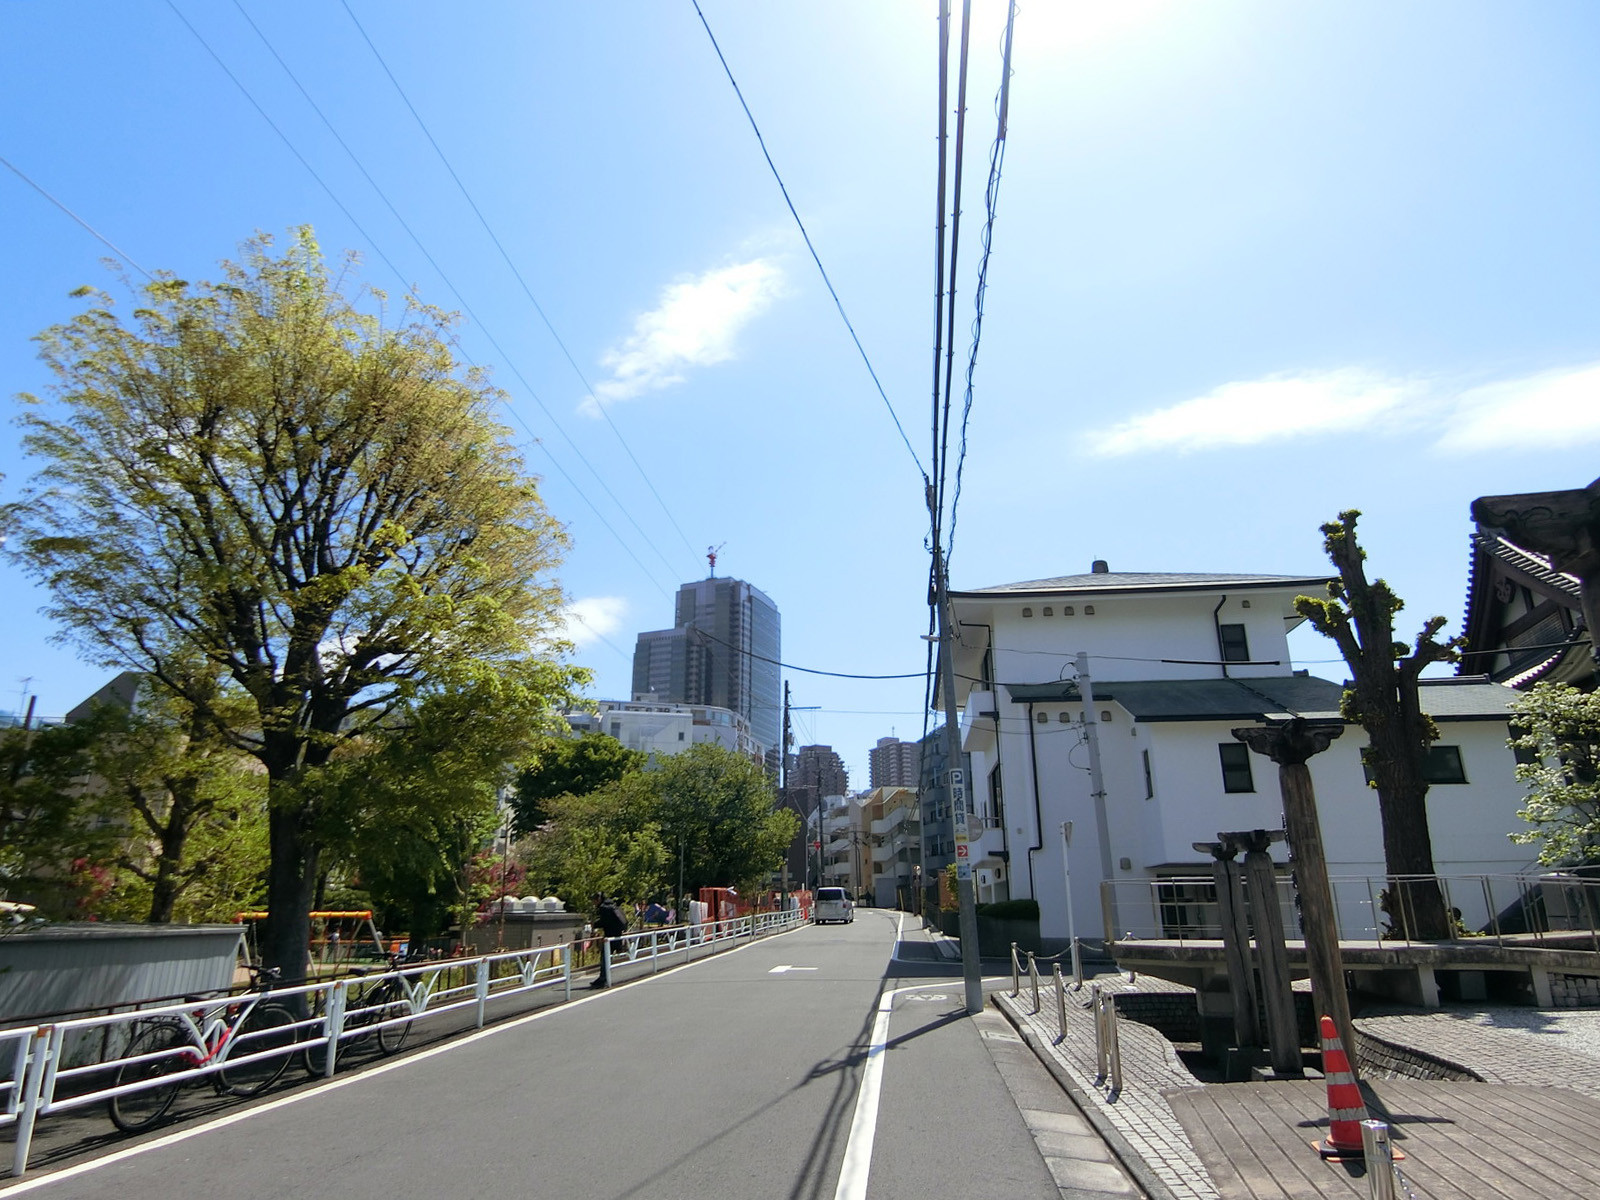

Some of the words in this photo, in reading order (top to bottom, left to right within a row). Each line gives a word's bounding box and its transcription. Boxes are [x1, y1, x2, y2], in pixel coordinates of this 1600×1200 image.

[952, 772, 962, 784] P
[953, 788, 965, 824] 時間貸
